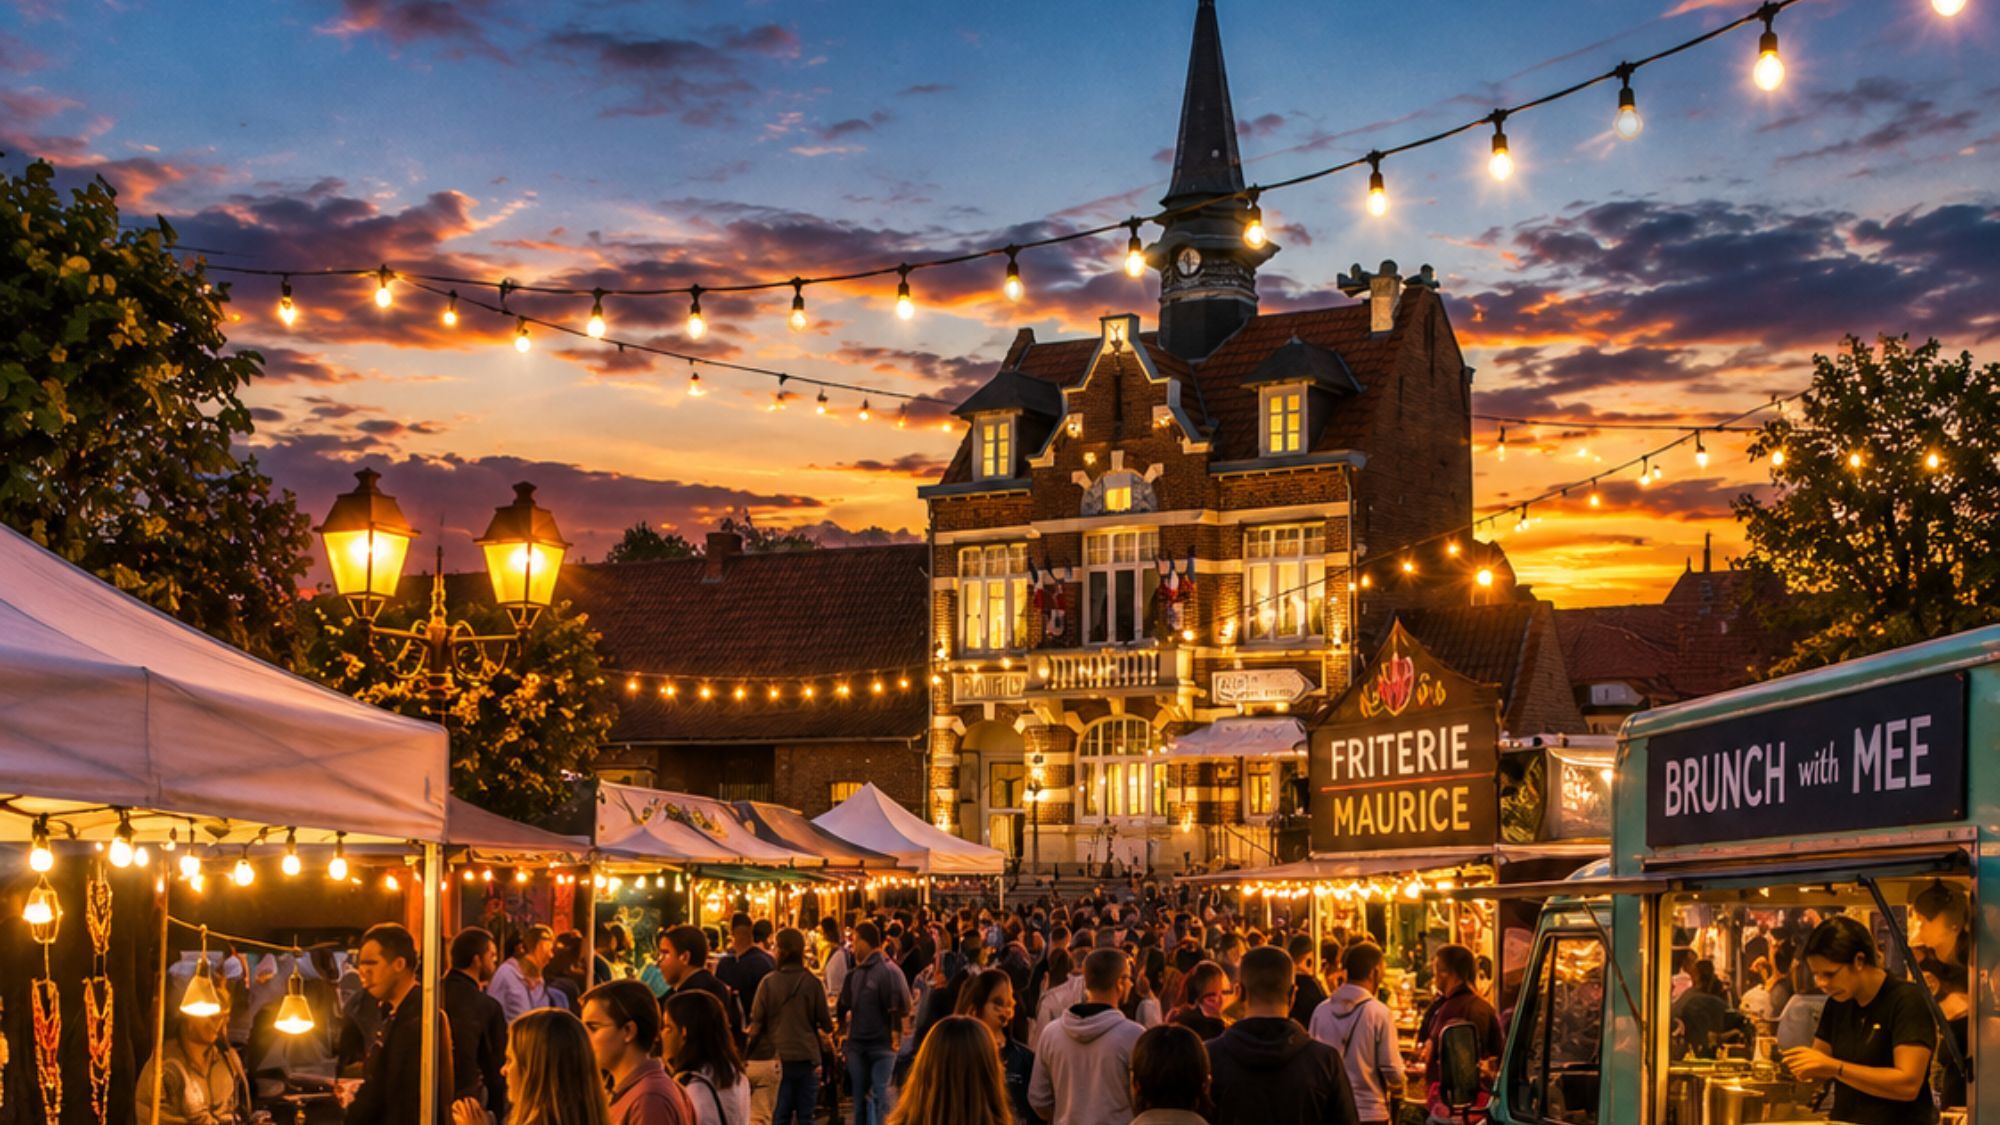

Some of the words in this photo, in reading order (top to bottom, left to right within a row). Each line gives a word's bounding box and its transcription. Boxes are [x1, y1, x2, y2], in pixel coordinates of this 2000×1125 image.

[1331, 724, 1469, 780] FRITERIE
[1665, 741, 1785, 816] BRUNCH
[1798, 741, 1839, 786] with
[1852, 715, 1931, 793] MEE
[1334, 786, 1470, 836] MAURICE
